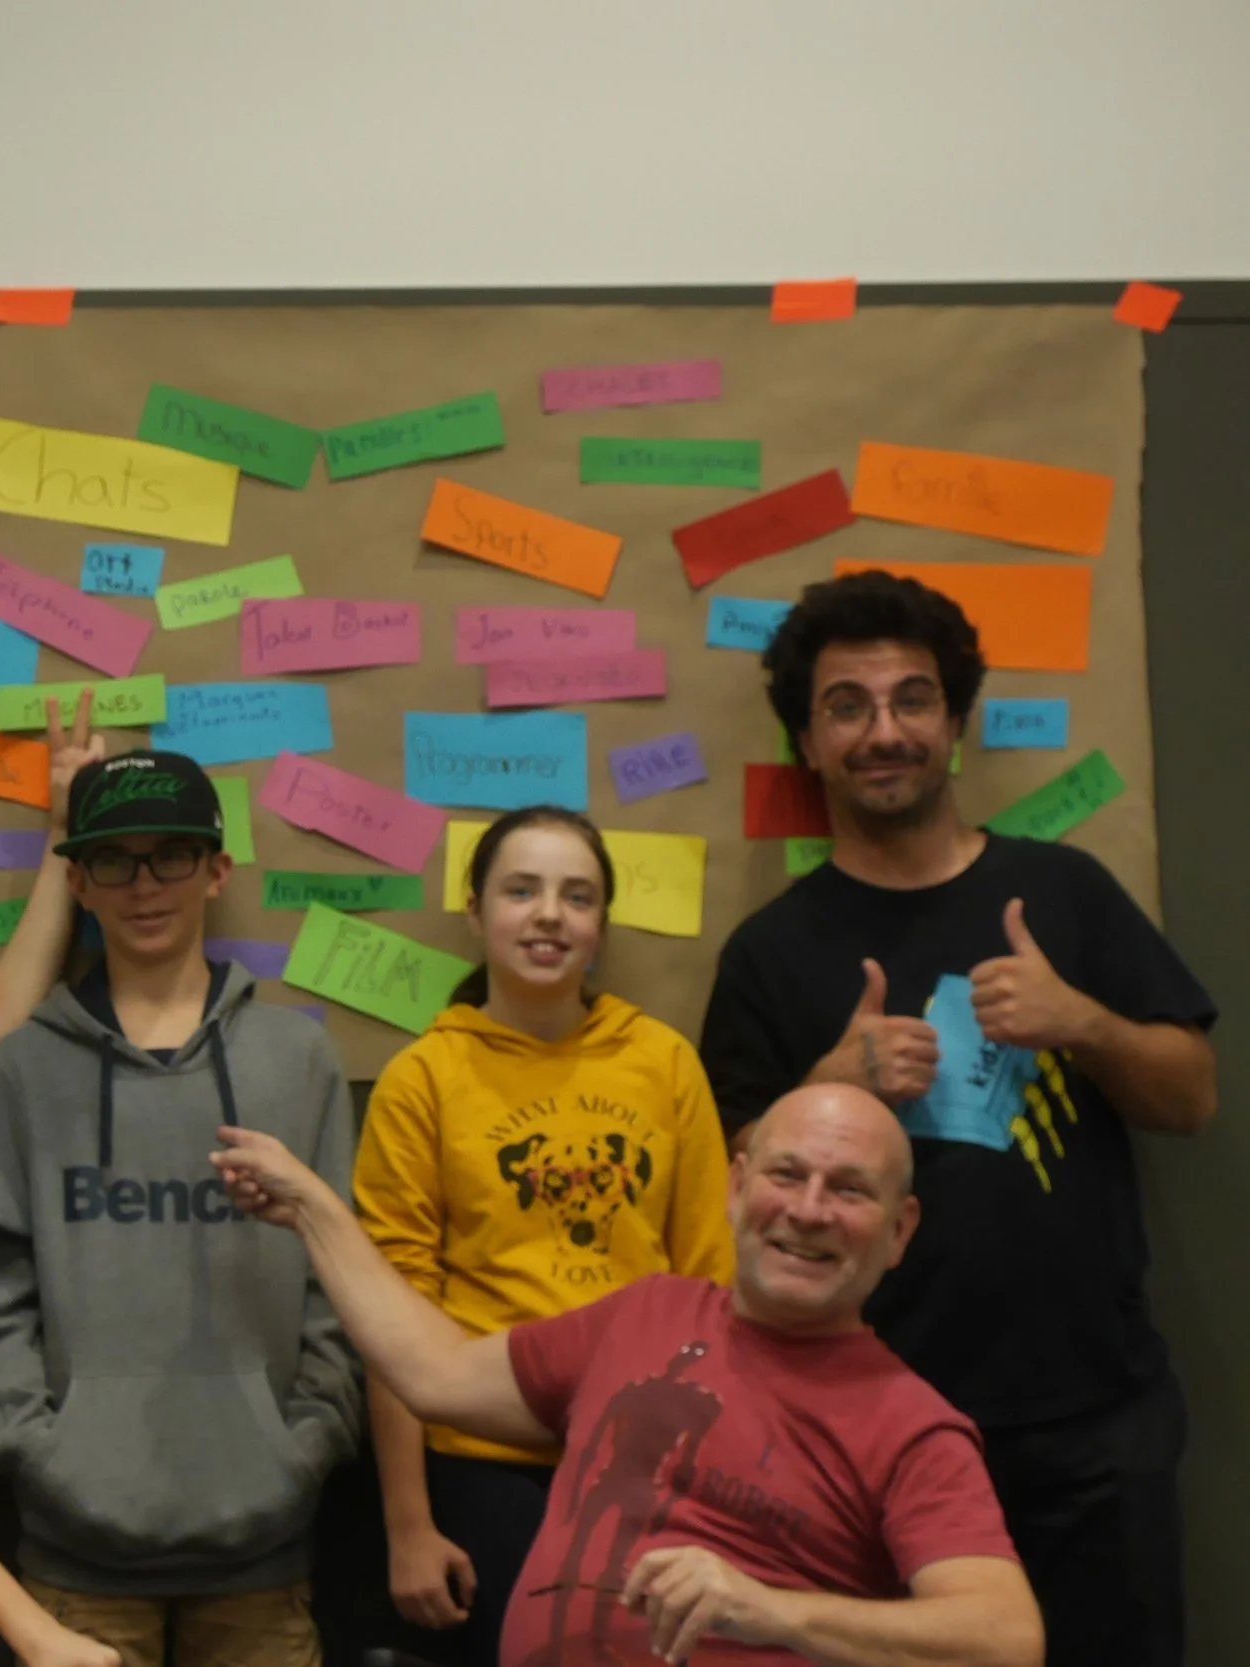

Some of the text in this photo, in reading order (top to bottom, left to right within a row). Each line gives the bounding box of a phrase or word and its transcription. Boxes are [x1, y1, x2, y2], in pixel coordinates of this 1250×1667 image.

[450, 491, 551, 571] Sports
[485, 1095, 557, 1142] WHAT
[63, 1165, 247, 1224] Benc
